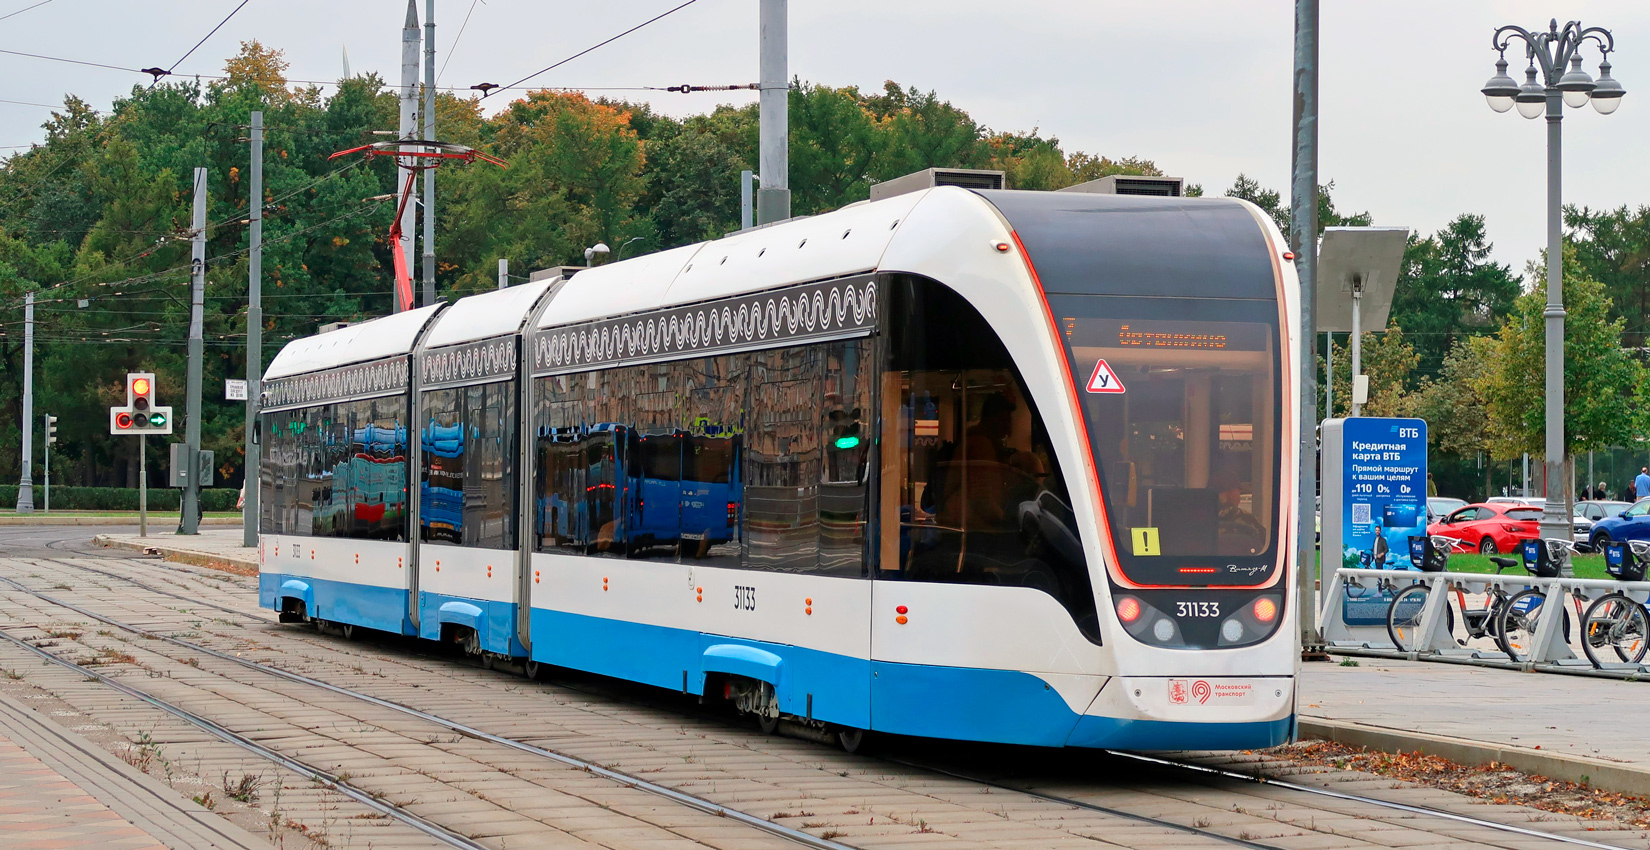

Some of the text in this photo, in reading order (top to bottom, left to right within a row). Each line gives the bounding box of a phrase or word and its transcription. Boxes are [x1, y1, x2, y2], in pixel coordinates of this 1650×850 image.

[1399, 428, 1419, 438] ВТБ
[1352, 441, 1406, 451] Кредитная
[1352, 452, 1400, 462] карта ВТБ
[1352, 464, 1418, 475] Прямой маршрут
[734, 585, 756, 612] 31133
[1176, 601, 1220, 617] 31133
